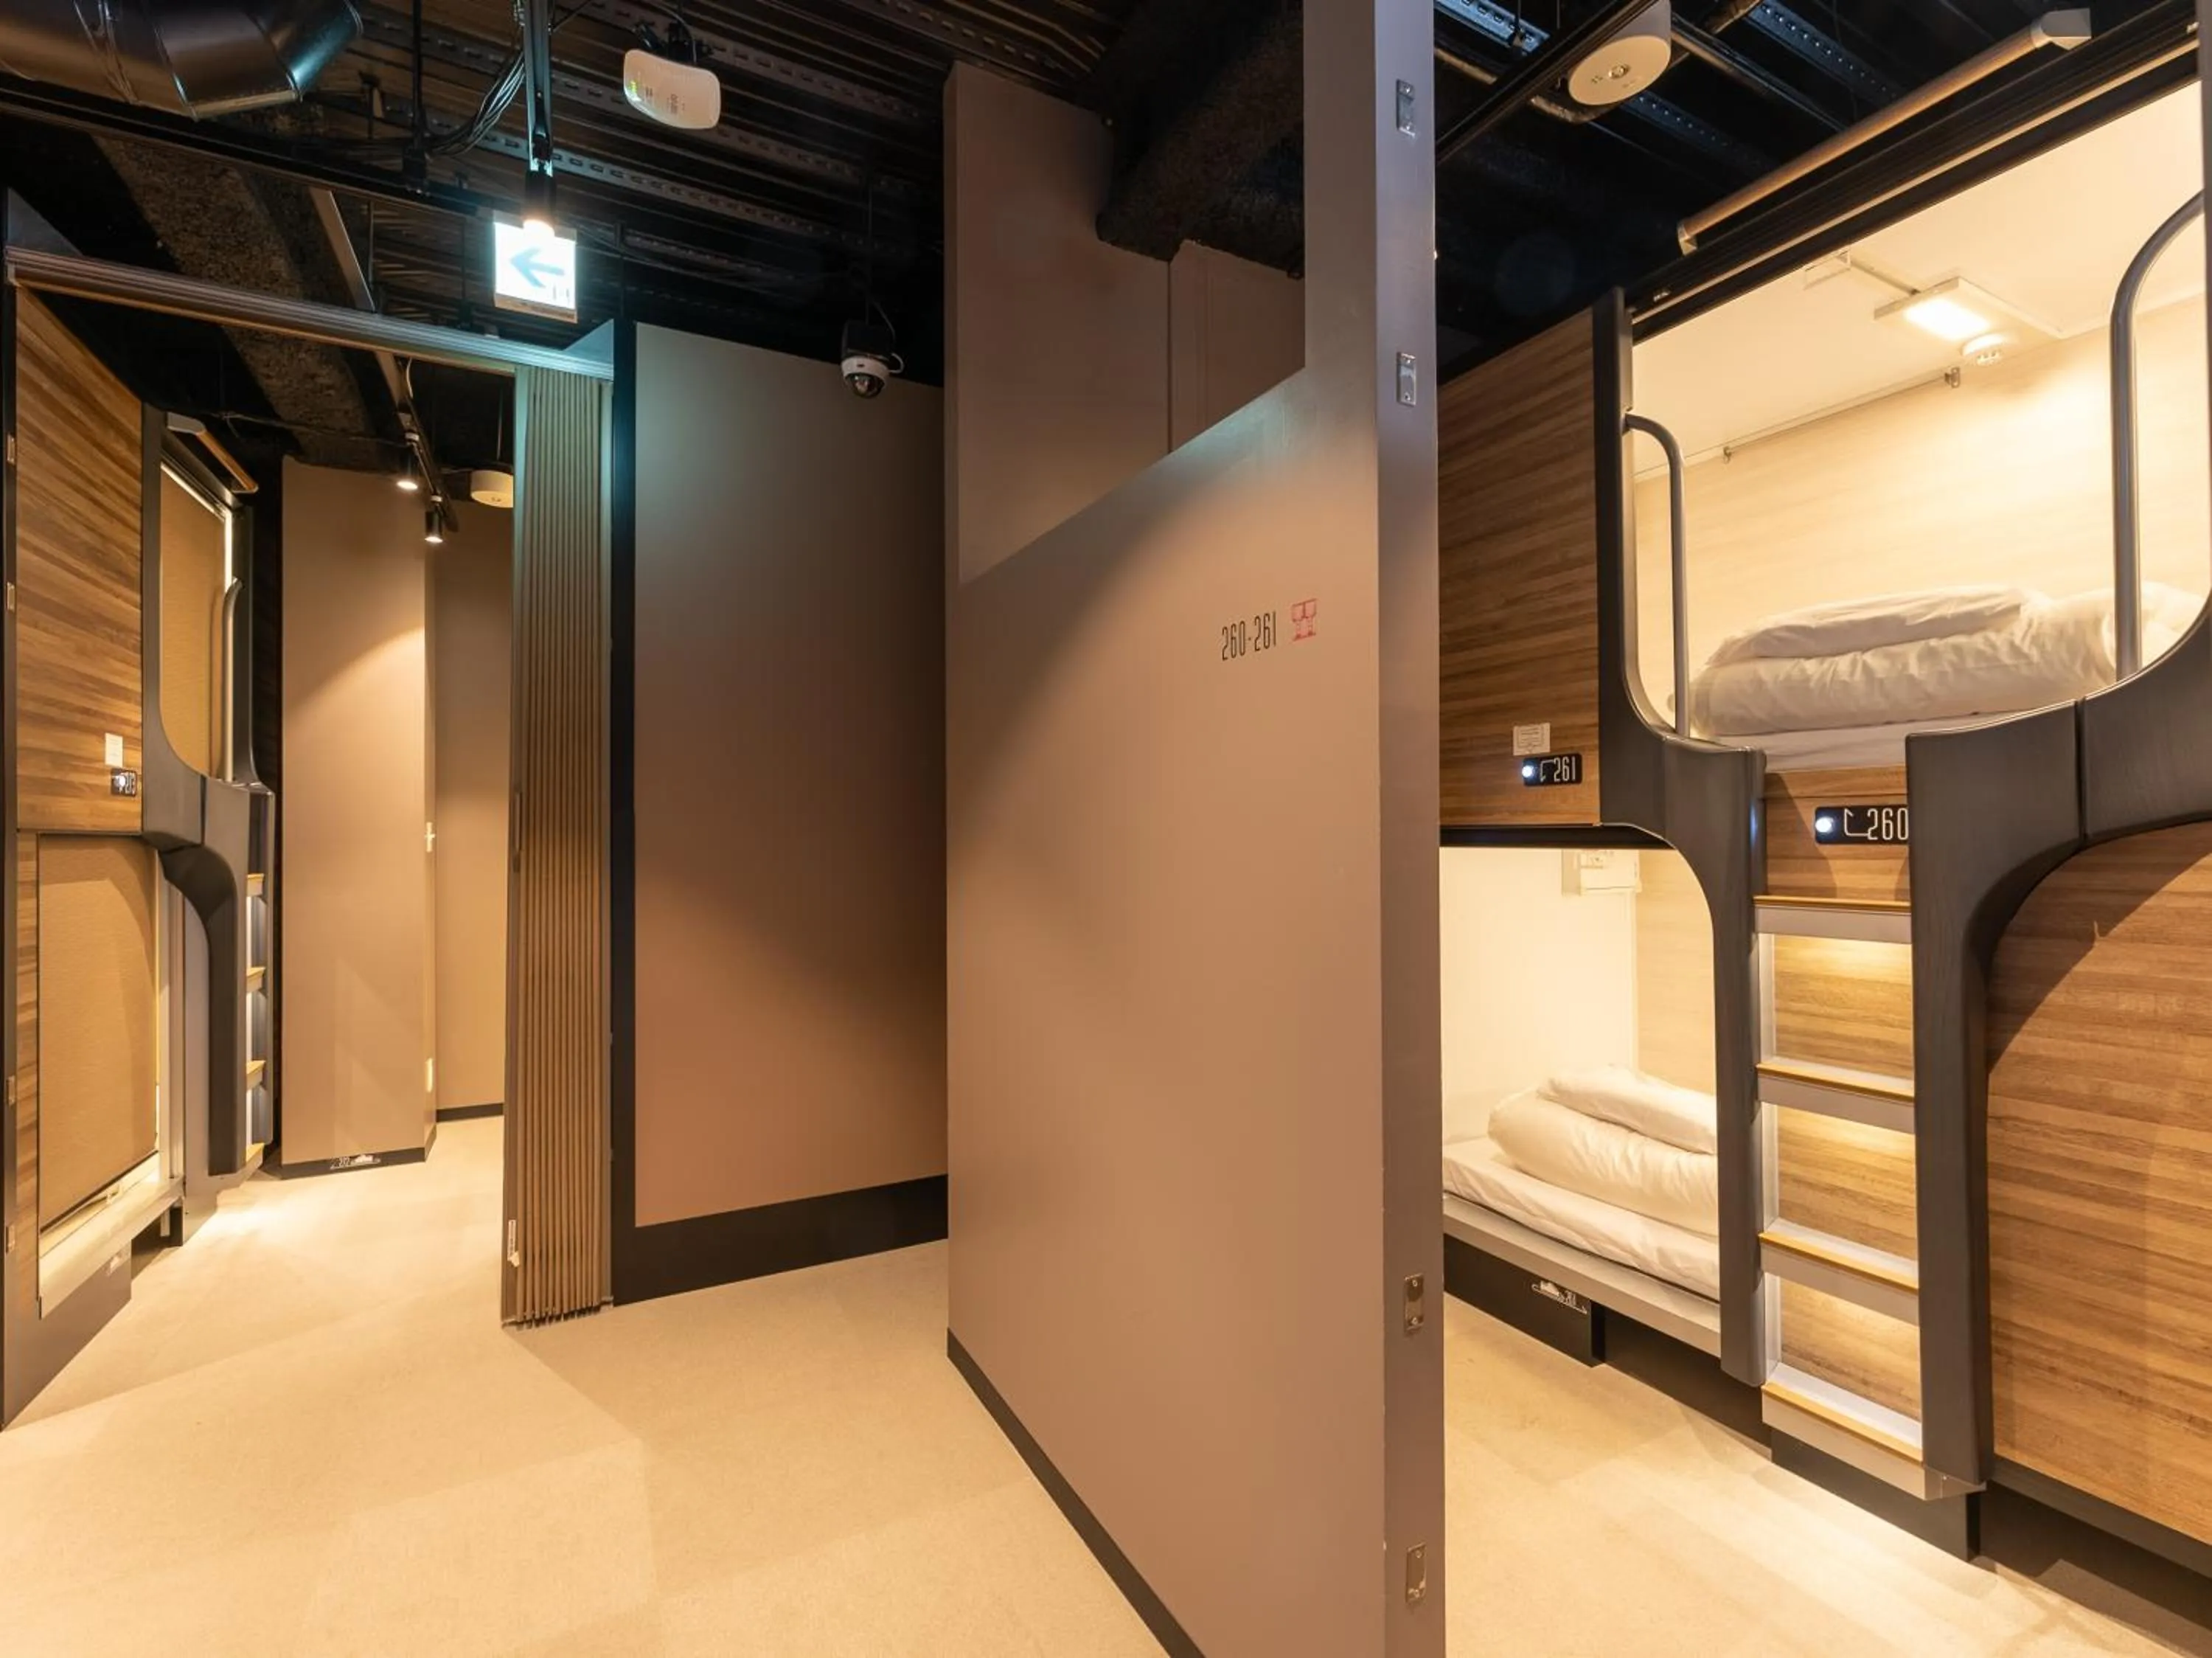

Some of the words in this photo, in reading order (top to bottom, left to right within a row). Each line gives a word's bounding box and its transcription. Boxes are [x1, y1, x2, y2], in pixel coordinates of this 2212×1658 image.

[1222, 611, 1276, 661] 260-261
[1554, 756, 1576, 783] 261
[1867, 808, 1909, 840] 260
